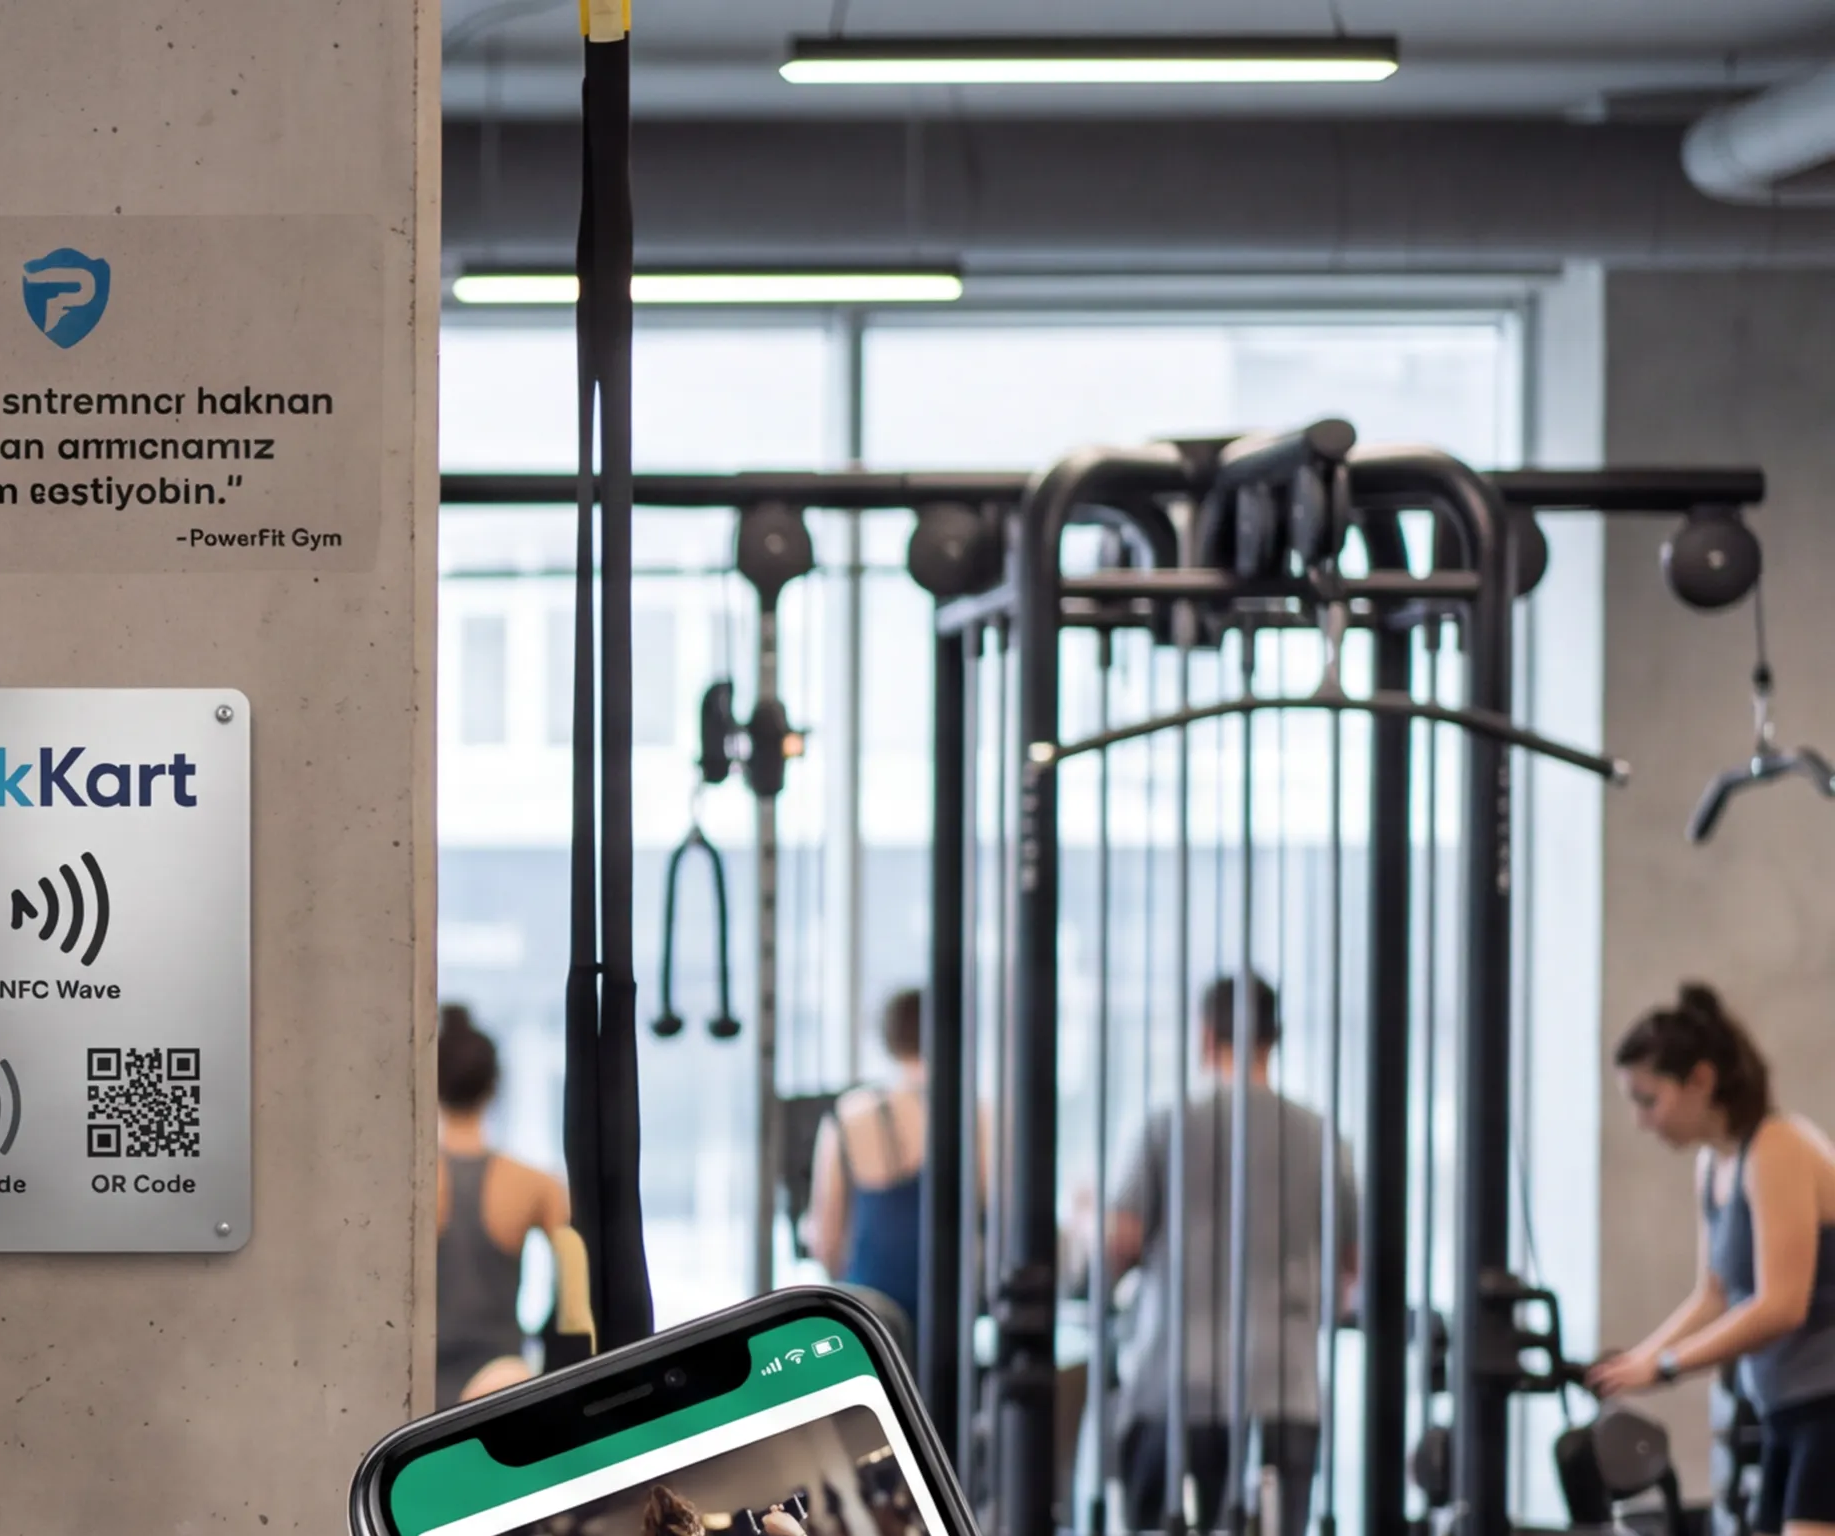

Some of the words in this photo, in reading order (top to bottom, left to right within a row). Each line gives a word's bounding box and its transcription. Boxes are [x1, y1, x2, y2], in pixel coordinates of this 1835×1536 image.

[197, 385, 333, 416] haknan
[291, 527, 342, 552] Gym
[0, 980, 49, 999] NFC
[56, 980, 121, 999] Wave
[133, 1174, 196, 1194] Code
